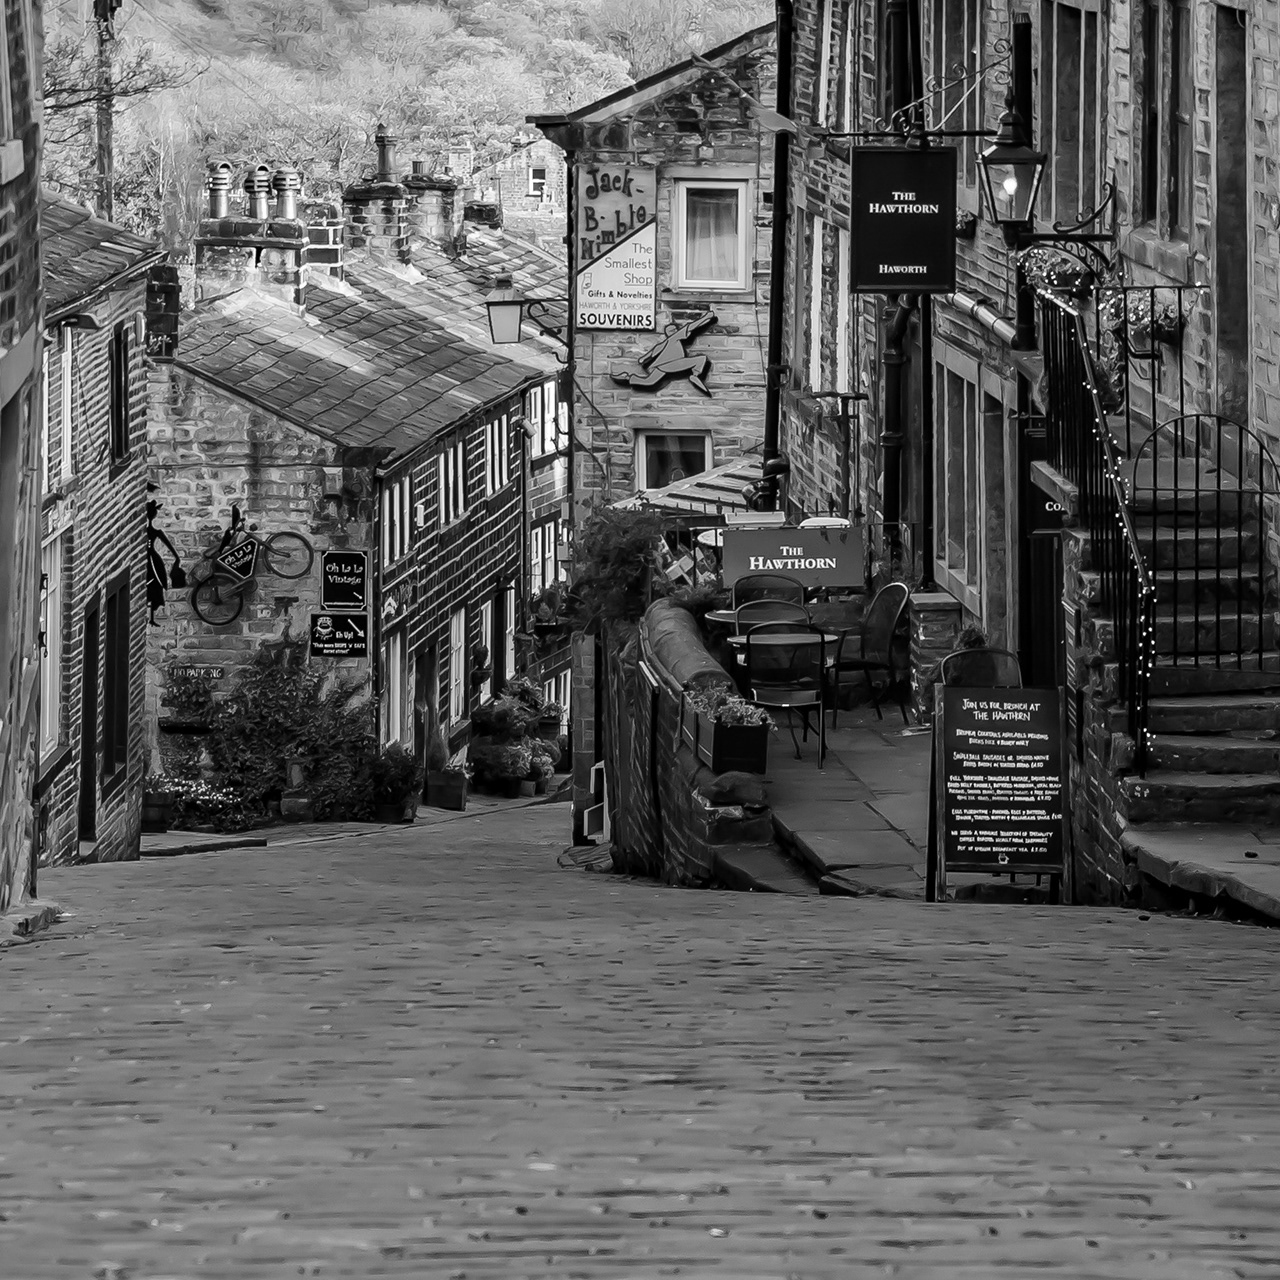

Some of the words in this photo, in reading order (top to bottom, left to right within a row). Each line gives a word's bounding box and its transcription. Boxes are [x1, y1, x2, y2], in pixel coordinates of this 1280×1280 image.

[891, 191, 917, 201] THE
[869, 203, 939, 214] HAWTHORN
[631, 242, 653, 254] The
[604, 257, 653, 269] Smallest
[879, 264, 927, 274] HAWORTH
[624, 272, 653, 286] Shop
[587, 290, 606, 298] Gifts
[608, 290, 615, 298] &
[617, 290, 653, 299] Novelties
[579, 301, 611, 309] HAWORTH
[612, 302, 617, 310] &
[619, 303, 652, 311] YORKSHIRE
[579, 313, 653, 327] SOUVENIRS
[780, 546, 804, 556] THE
[224, 555, 236, 565] Oh
[749, 557, 836, 570] HAWTHORN
[326, 562, 339, 573] Oh
[341, 564, 351, 573] La
[353, 564, 363, 573] La
[328, 575, 361, 585] Vintage
[962, 698, 977, 710] JOIN
[979, 701, 988, 709] US
[990, 701, 1002, 710] FOR
[1029, 703, 1041, 711] AT
[973, 711, 989, 720] THE
[992, 712, 1030, 721] HAWTHORN
